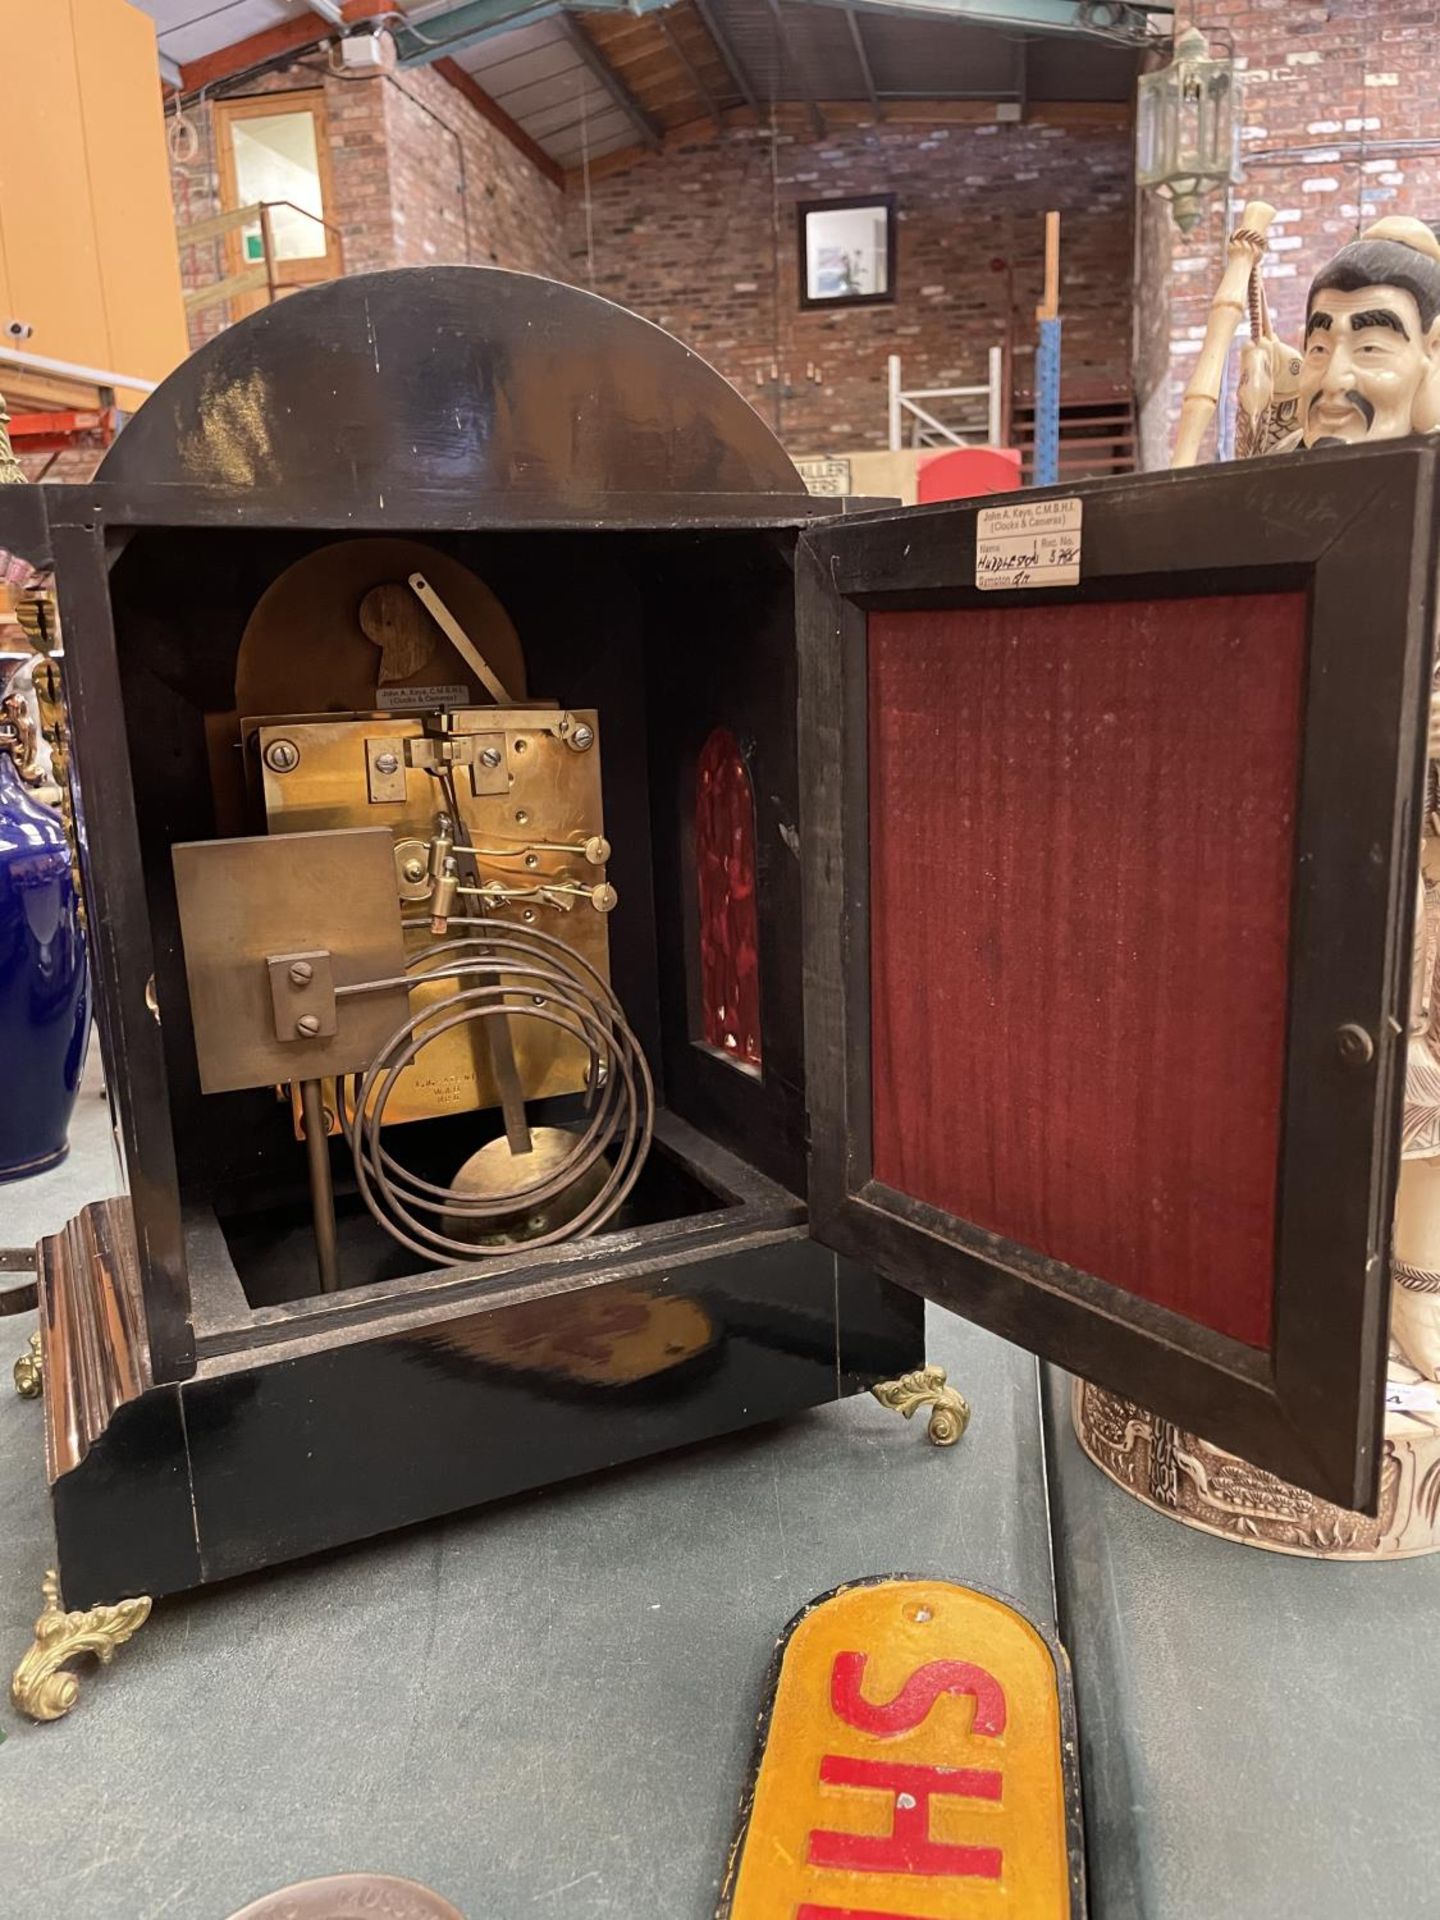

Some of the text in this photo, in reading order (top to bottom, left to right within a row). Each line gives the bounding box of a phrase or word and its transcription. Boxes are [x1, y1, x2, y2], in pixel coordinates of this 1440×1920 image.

[984, 512, 1001, 521] John
[991, 521, 1019, 533] (Clocks
[1021, 519, 1027, 528] &
[980, 544, 999, 554] Name
